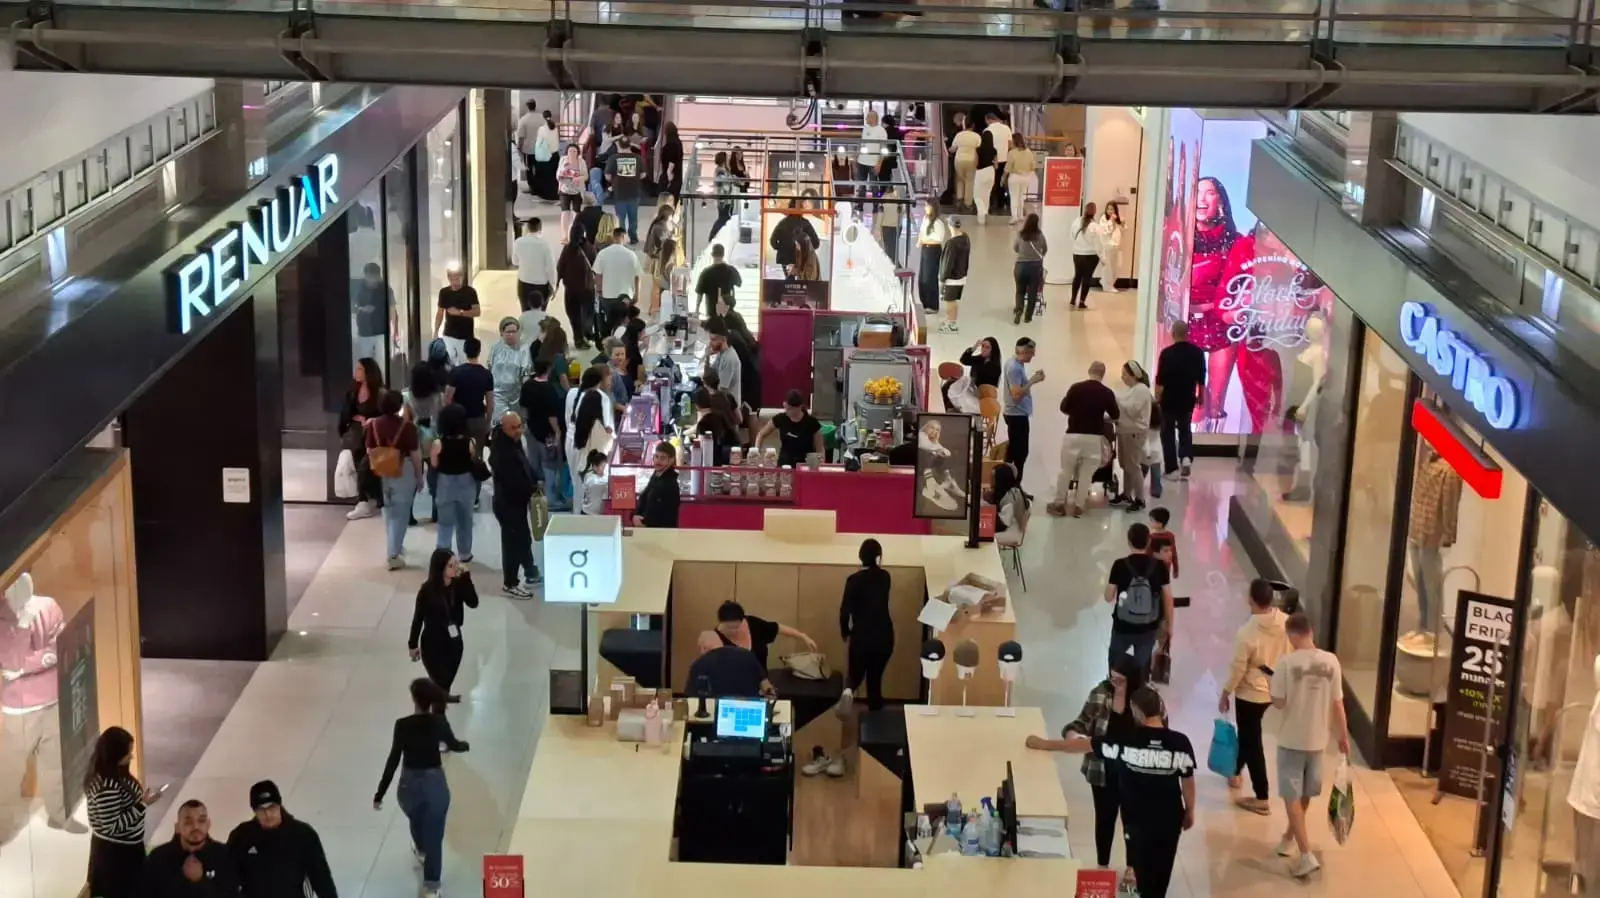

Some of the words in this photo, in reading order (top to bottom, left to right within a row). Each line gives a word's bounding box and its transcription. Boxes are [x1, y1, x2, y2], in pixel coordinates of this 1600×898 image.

[178, 152, 339, 334] RENUAR
[1219, 273, 1327, 310] Black
[1227, 308, 1312, 352] Friday
[1400, 301, 1516, 429] CASTRO
[1120, 746, 1173, 769] JEANS
